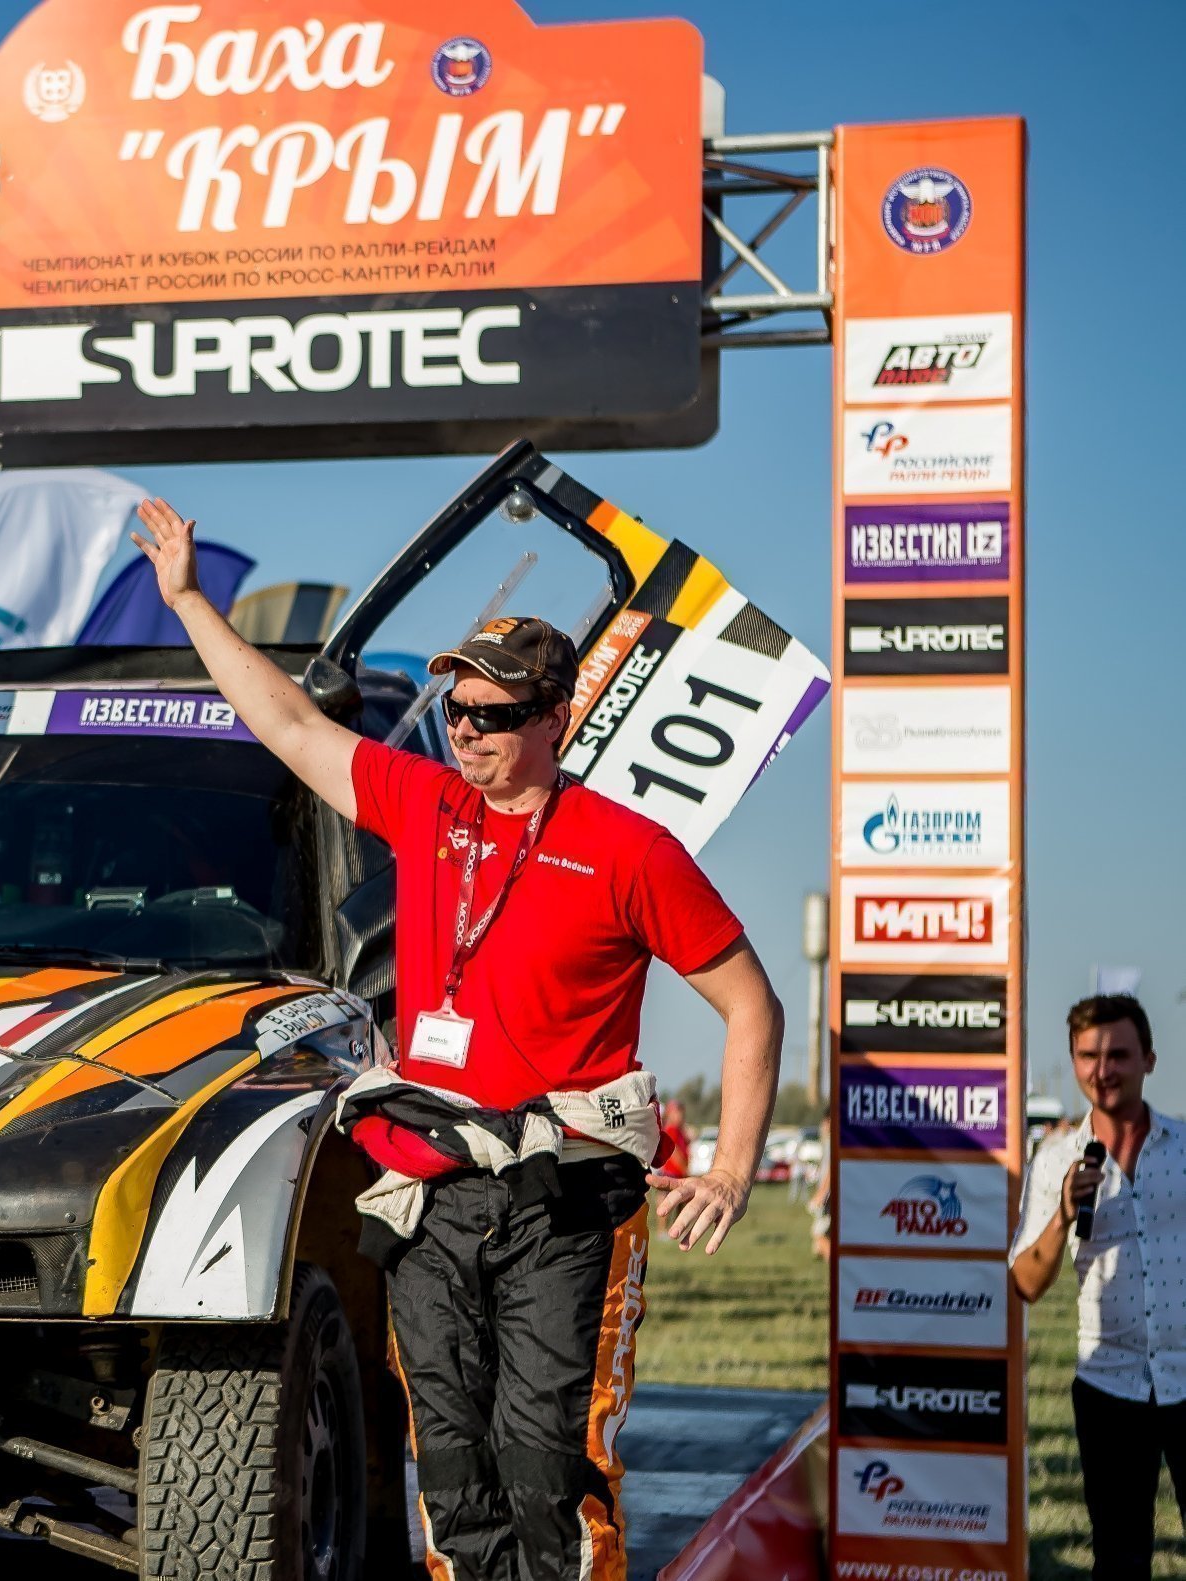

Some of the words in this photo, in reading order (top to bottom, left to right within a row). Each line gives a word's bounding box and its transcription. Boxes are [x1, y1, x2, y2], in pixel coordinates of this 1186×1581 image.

[121, 5, 394, 100] Баха
[118, 103, 626, 233] "КРЫМ"
[23, 254, 135, 272] ЧЕМПИОНАТ
[141, 253, 154, 267] И
[159, 250, 217, 267] КУБОК
[226, 247, 304, 265] РОССИИ
[314, 246, 336, 260] ПО
[341, 238, 497, 258] РАЛЛИ-РЕЙДАМ
[22, 276, 142, 295] ЧЕМПИОНАТ
[147, 272, 227, 291] РОССИИ
[233, 270, 260, 287] ПО
[267, 264, 419, 285] КРОСС-КАНТРИ
[426, 261, 497, 279] РАЛЛИ
[59, 307, 521, 400] SUPROTEC
[884, 343, 988, 371] АВТО
[851, 523, 962, 561] ИЗВЕСТИЯ
[873, 624, 1004, 653] SUPROTEC
[81, 698, 197, 724] ИЗВЕСТИЯ
[572, 644, 662, 752] SUPROTEC
[627, 673, 764, 806] 101
[902, 811, 982, 829] ГАЗПРОМ
[464, 841, 479, 883] MOOG
[455, 901, 468, 946] MOOG
[871, 1000, 1001, 1028] SUPROTEC
[847, 1085, 959, 1122] ИЗВЕСТИЯ
[871, 1385, 1002, 1415] SUPROTEC
